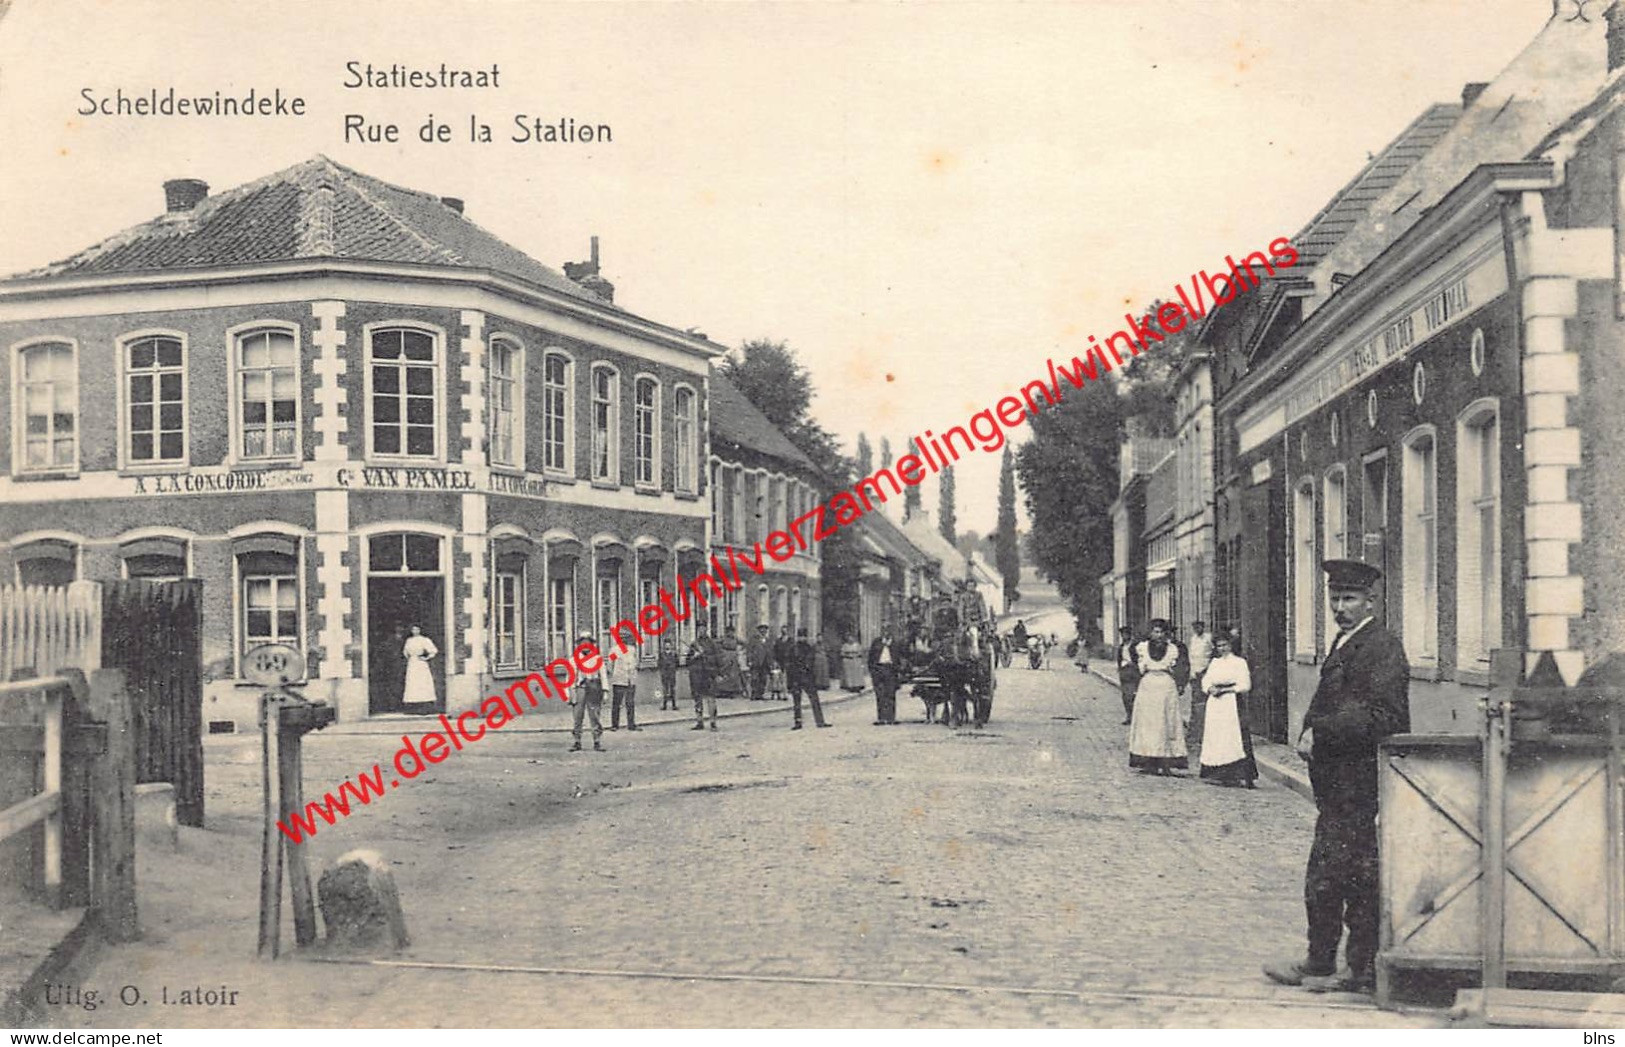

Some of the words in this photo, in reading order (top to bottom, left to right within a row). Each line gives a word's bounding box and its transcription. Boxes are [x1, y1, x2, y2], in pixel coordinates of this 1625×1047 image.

[155, 474, 181, 493] LA
[184, 471, 267, 492] CONCORDE
[362, 467, 400, 488] VAN
[405, 468, 476, 489] PAMEL
